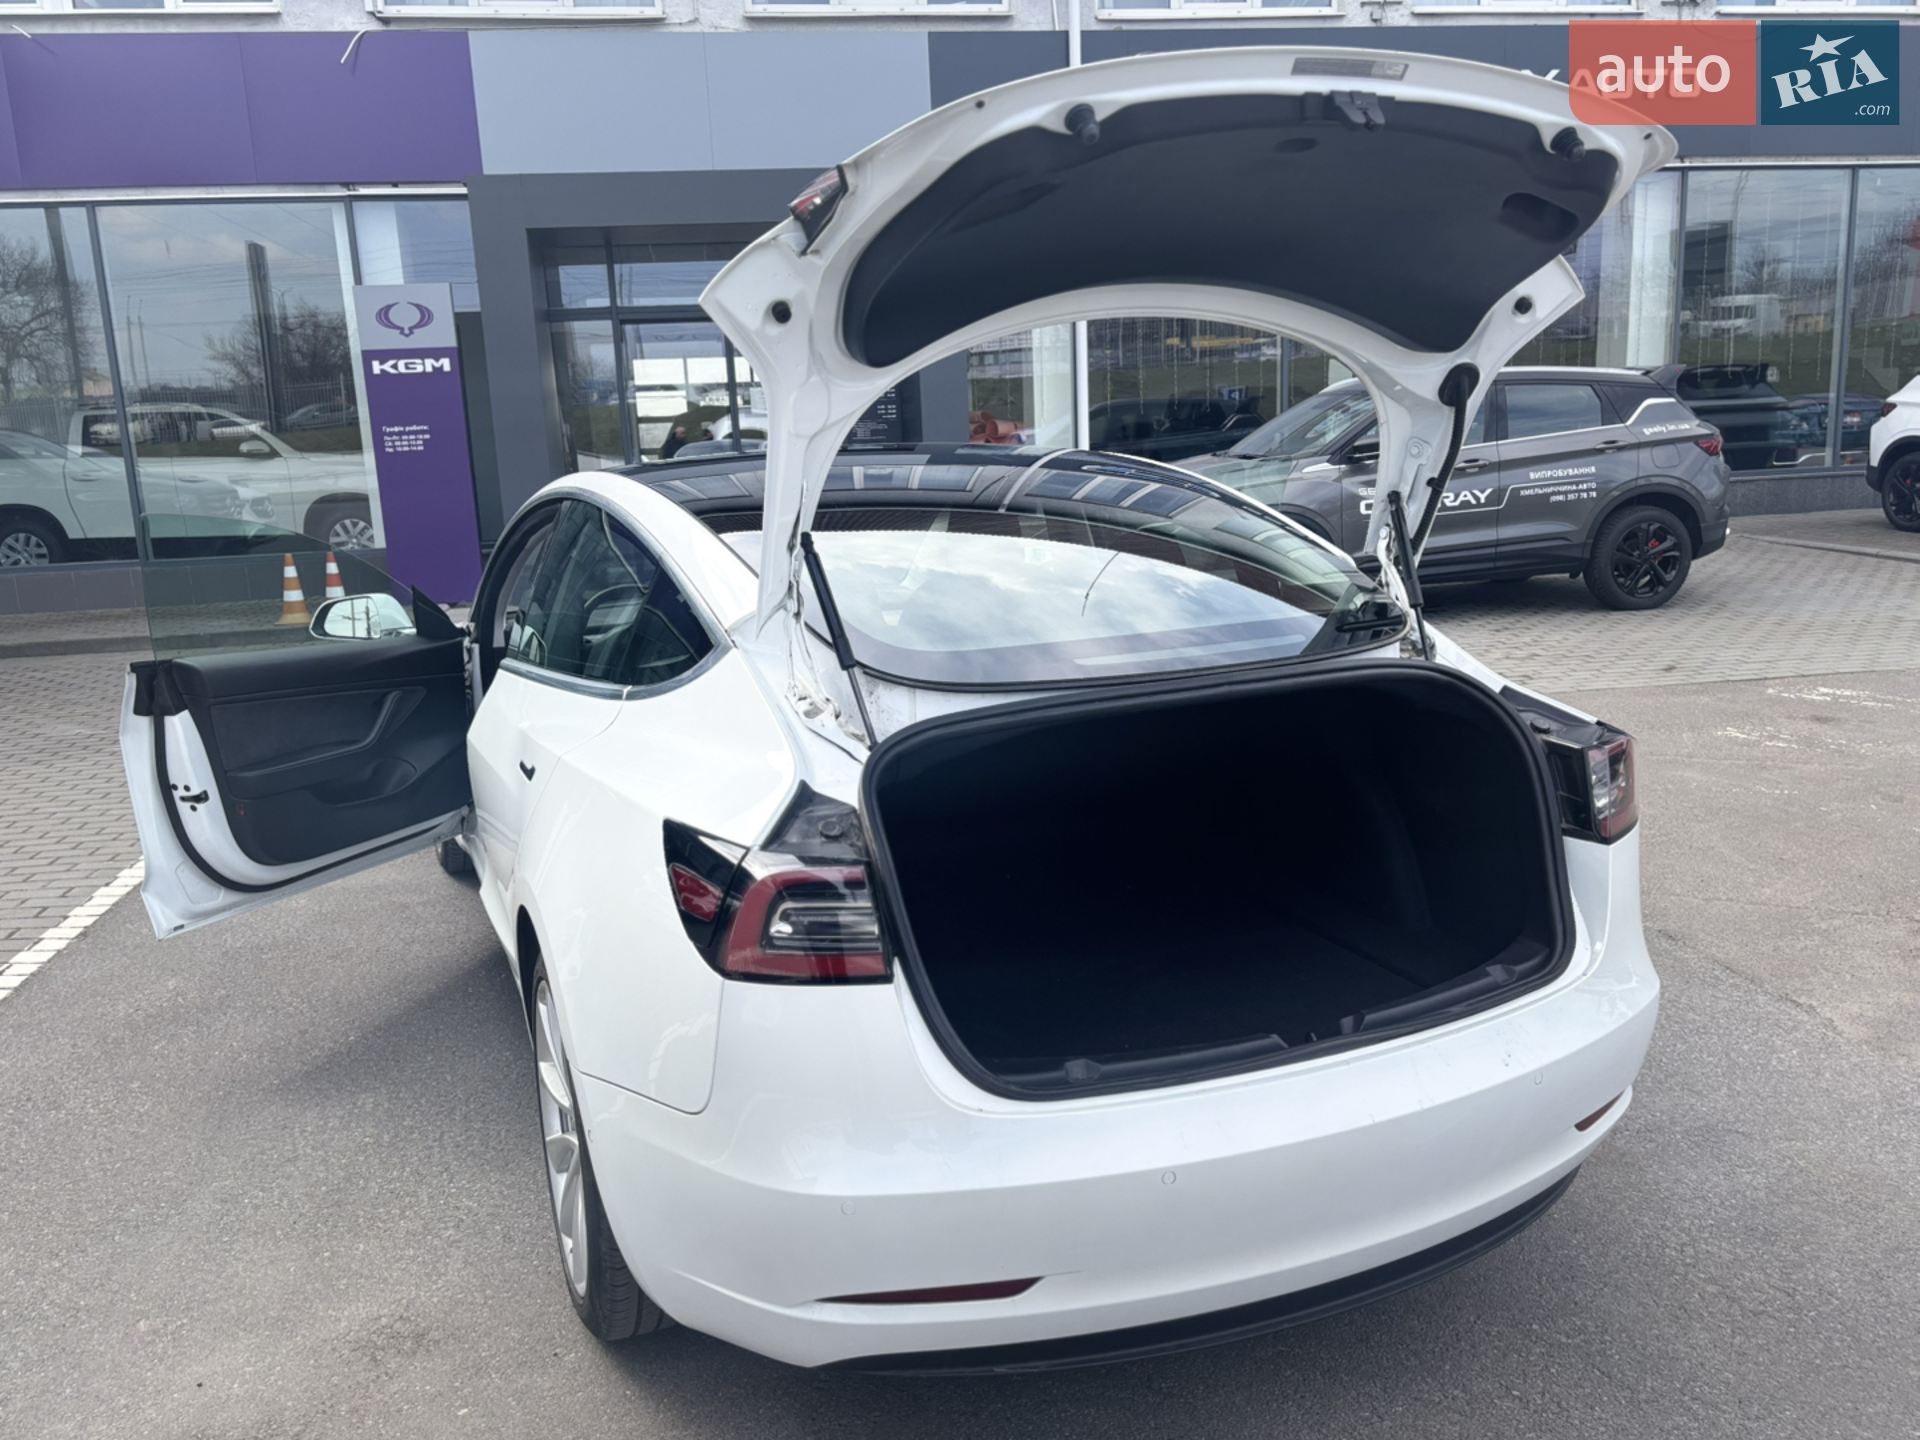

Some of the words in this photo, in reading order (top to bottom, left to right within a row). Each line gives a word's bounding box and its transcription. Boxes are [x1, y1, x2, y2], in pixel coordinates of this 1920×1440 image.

[371, 358, 451, 374] KGM
[1529, 466, 1596, 479] ВИПРОБУВАННЯ
[1360, 487, 1494, 515] CRAY
[1567, 492, 1579, 501] 357
[1579, 491, 1588, 499] 78
[1588, 490, 1597, 499] 78
